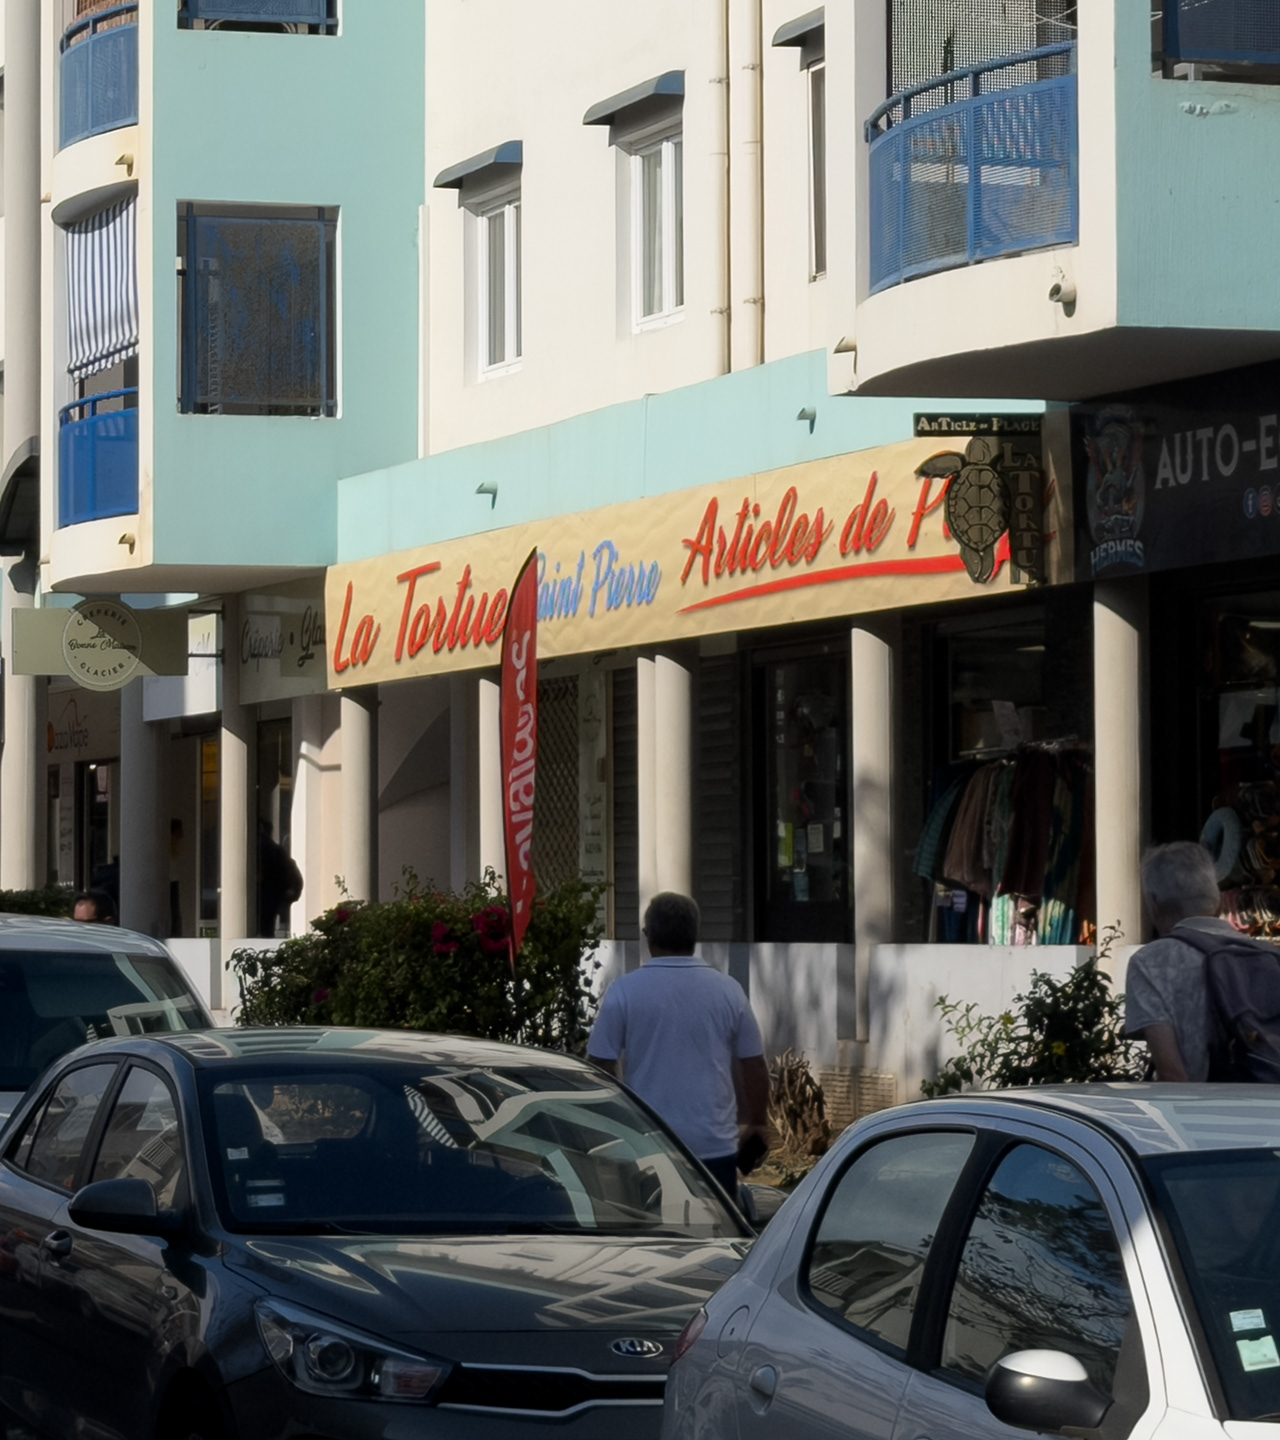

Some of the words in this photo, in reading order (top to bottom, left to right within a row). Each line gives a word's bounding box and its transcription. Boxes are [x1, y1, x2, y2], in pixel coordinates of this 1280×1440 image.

[681, 486, 835, 586] Articles
[840, 470, 896, 558] de
[589, 540, 662, 618] Pierre
[1090, 538, 1145, 577] HERMES
[333, 580, 380, 674] La
[394, 561, 508, 662] Tortue
[80, 662, 125, 677] GLACIER
[619, 1340, 656, 1352] KIA
